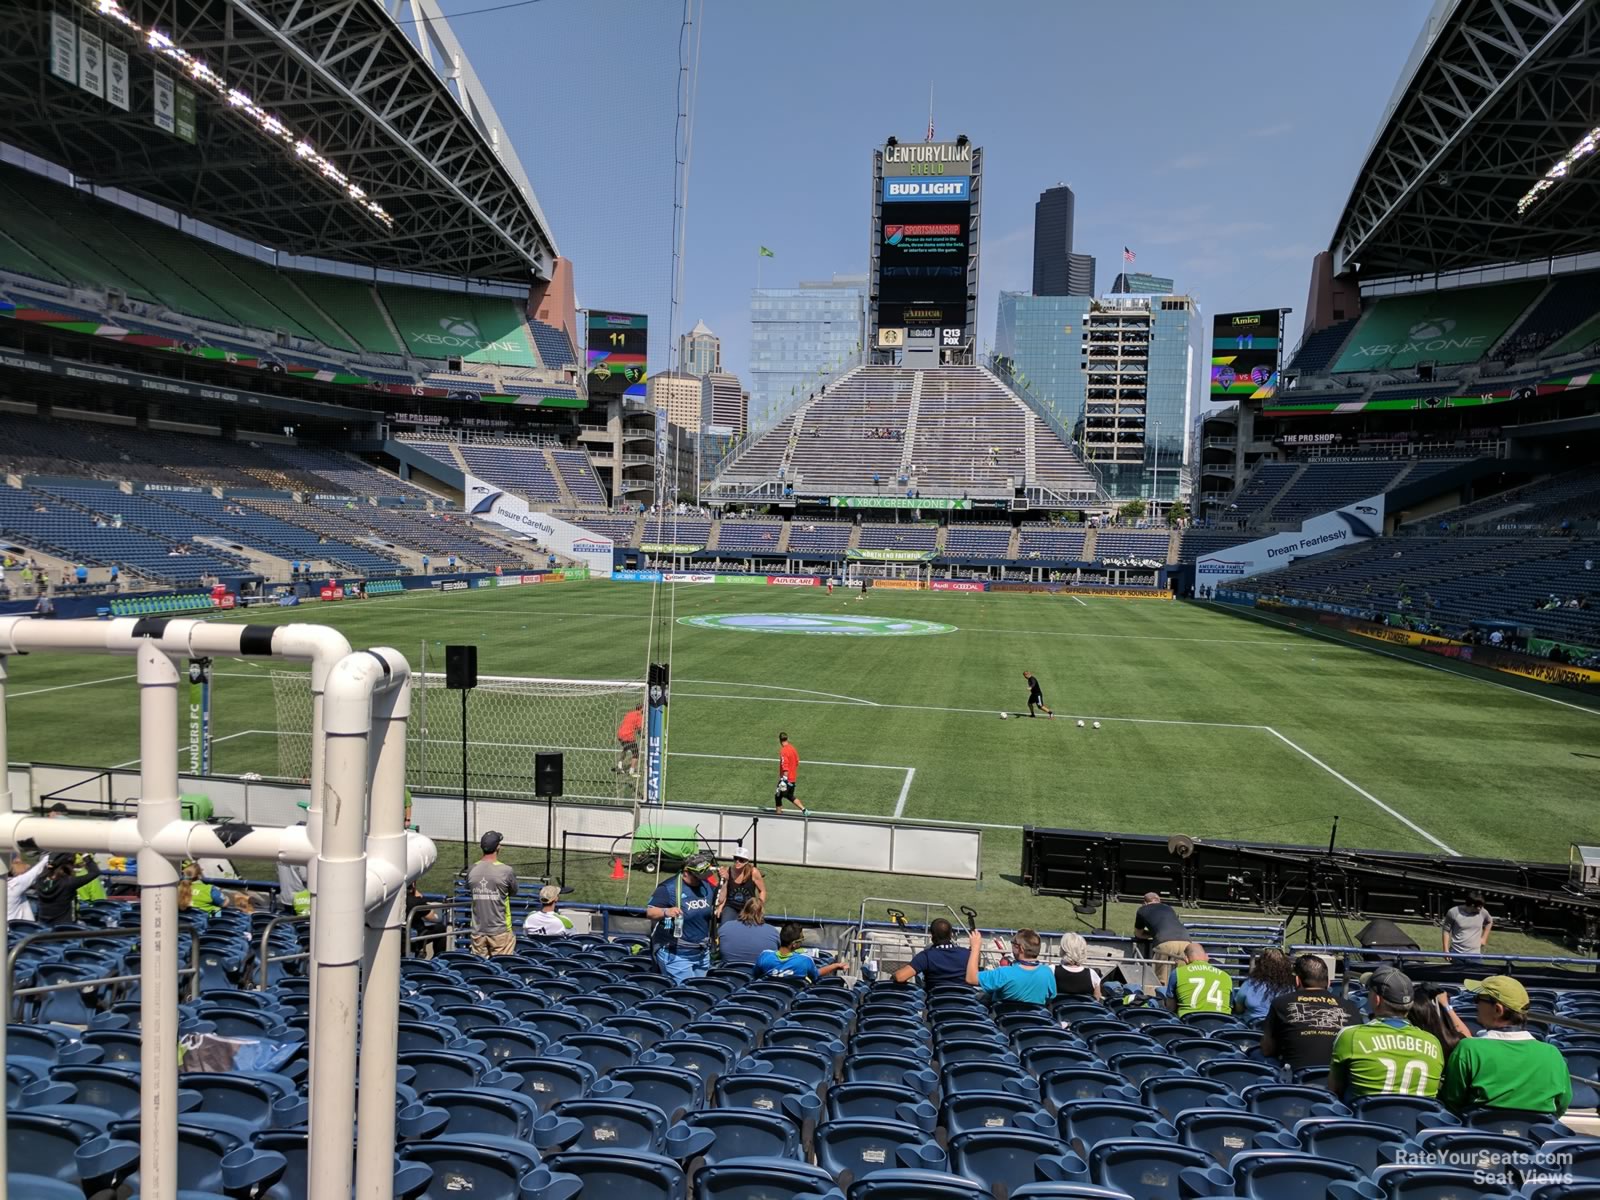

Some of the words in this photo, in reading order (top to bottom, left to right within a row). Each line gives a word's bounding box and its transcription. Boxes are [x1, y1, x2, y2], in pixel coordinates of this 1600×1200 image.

[911, 163, 944, 174] FIELD
[890, 184, 919, 195] BUD
[921, 183, 964, 194] LIGHT
[905, 225, 959, 235] SPORTSMANSHIP
[906, 310, 940, 318] Amica
[1235, 317, 1259, 325] Amica
[943, 329, 961, 337] Q13
[411, 332, 474, 348] XBOX
[475, 341, 523, 352] ONE
[610, 333, 625, 347] 11
[1236, 334, 1252, 350] 11
[1352, 342, 1424, 357] XBOX
[1425, 336, 1487, 351] ONE
[224, 351, 238, 363] VS
[410, 387, 424, 396] VS
[1481, 393, 1493, 404] VS
[395, 413, 408, 421] THE
[857, 499, 884, 507] XBOX
[885, 499, 914, 508] GREEN
[917, 500, 945, 508] ZONE
[497, 506, 521, 521] Insure
[522, 516, 555, 536] Carefully
[1267, 544, 1299, 558] Dream
[1300, 530, 1347, 548] Fearlessly
[190, 704, 200, 720] FC
[686, 899, 709, 910] XBOX
[1187, 964, 1223, 976] CHURCHY
[1188, 978, 1224, 1012] 74
[1358, 1035, 1438, 1059] LJUNGBERG
[1377, 1058, 1430, 1096] 10
